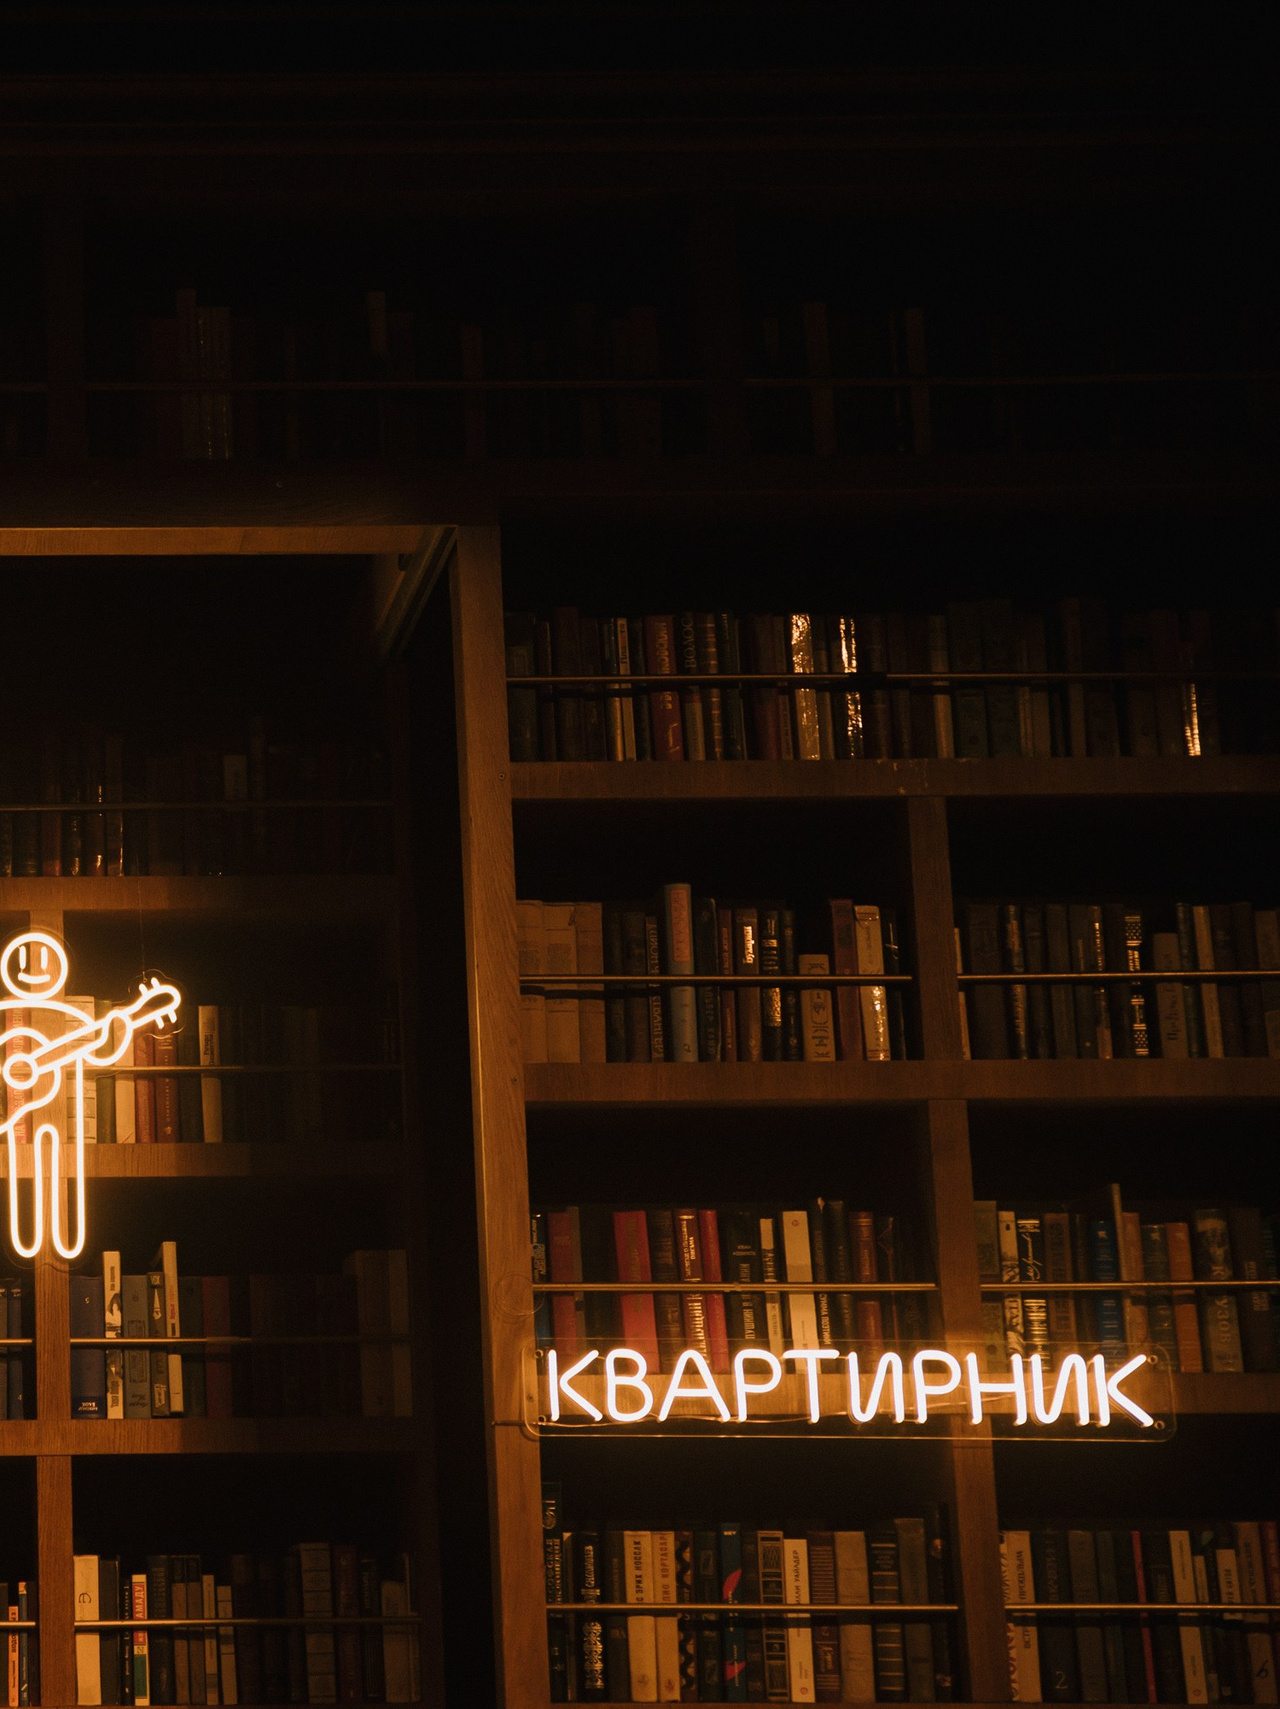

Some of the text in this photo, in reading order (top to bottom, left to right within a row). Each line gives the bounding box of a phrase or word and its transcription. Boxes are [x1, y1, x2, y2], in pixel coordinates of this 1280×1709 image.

[680, 617, 697, 668] ВОЛОС
[741, 1308, 756, 1340] ПУШКИН
[1211, 1264, 1231, 1343] КУЗОВ
[546, 1347, 1155, 1428] КВАРТИРНИК
[631, 1540, 644, 1594] ЭРИХ НОССАК
[658, 1535, 670, 1579] КОРТАСАР
[792, 1549, 801, 1583] УАЙЛДЕР
[1016, 1550, 1027, 1600] ПРОШЛЫМ
[133, 1585, 145, 1619] АМАДУ
[1054, 1671, 1069, 1690] 2
